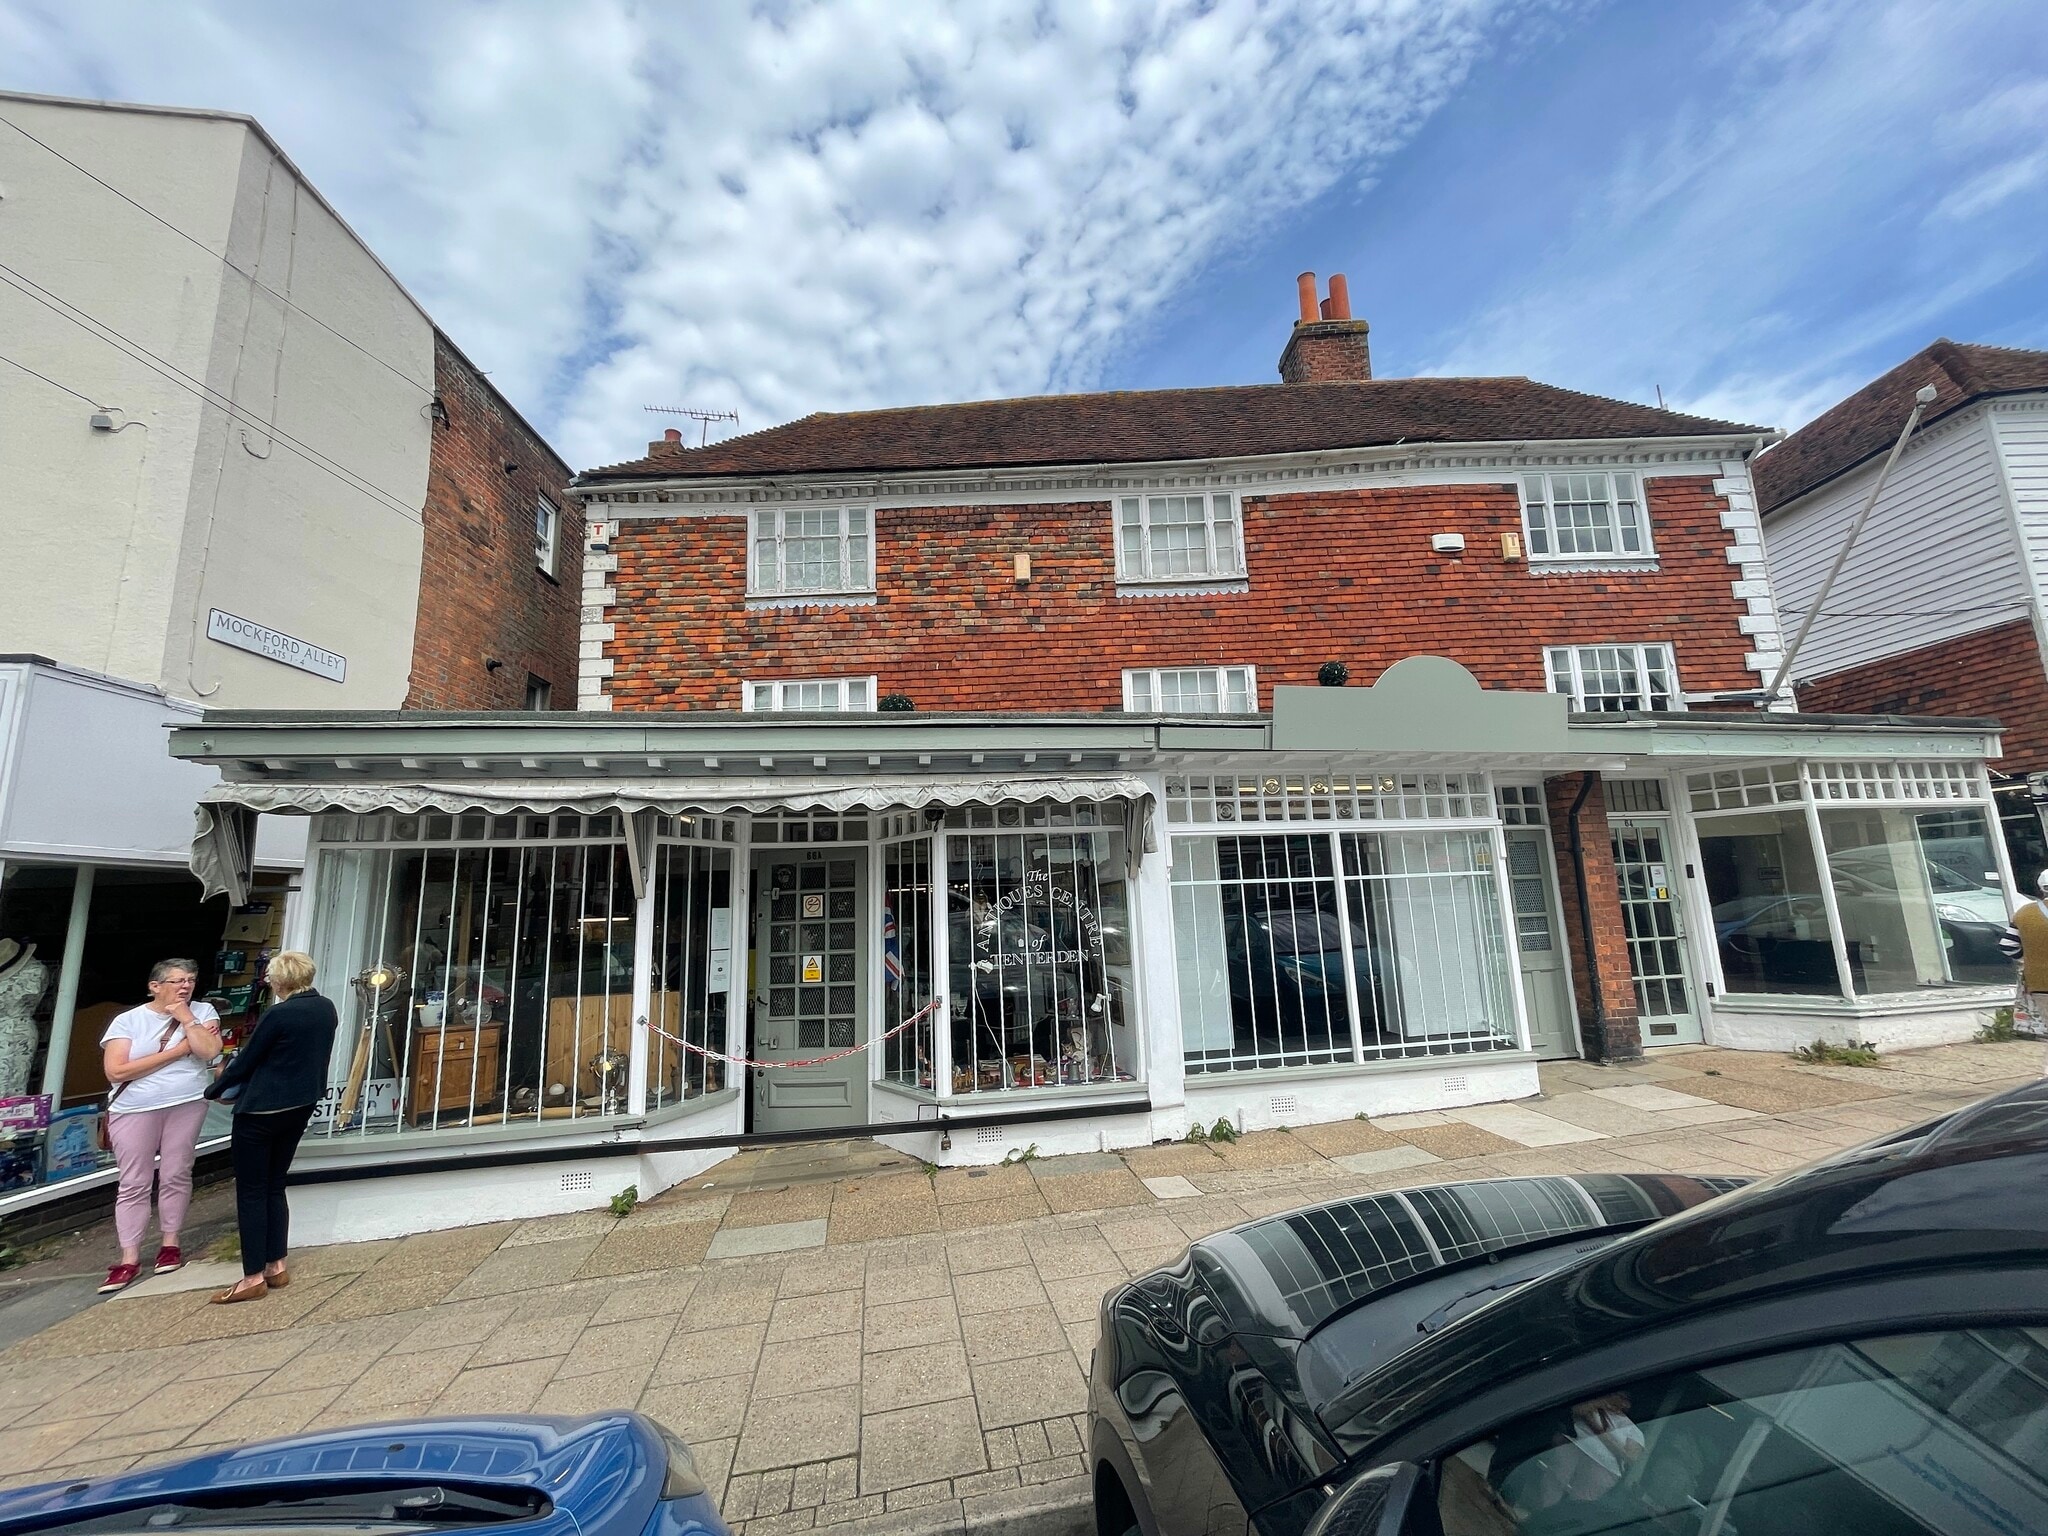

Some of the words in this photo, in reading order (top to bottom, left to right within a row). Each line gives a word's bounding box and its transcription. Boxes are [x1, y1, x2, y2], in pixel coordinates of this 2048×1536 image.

[593, 524, 604, 536] T
[216, 614, 300, 654] MOCKFORD
[304, 647, 341, 669] ALLEY
[262, 646, 286, 660] FLATS
[1026, 869, 1049, 882] The
[976, 884, 1044, 953] ANTIQUES
[1031, 934, 1047, 951] of
[990, 949, 1089, 967] TENTERDEN
